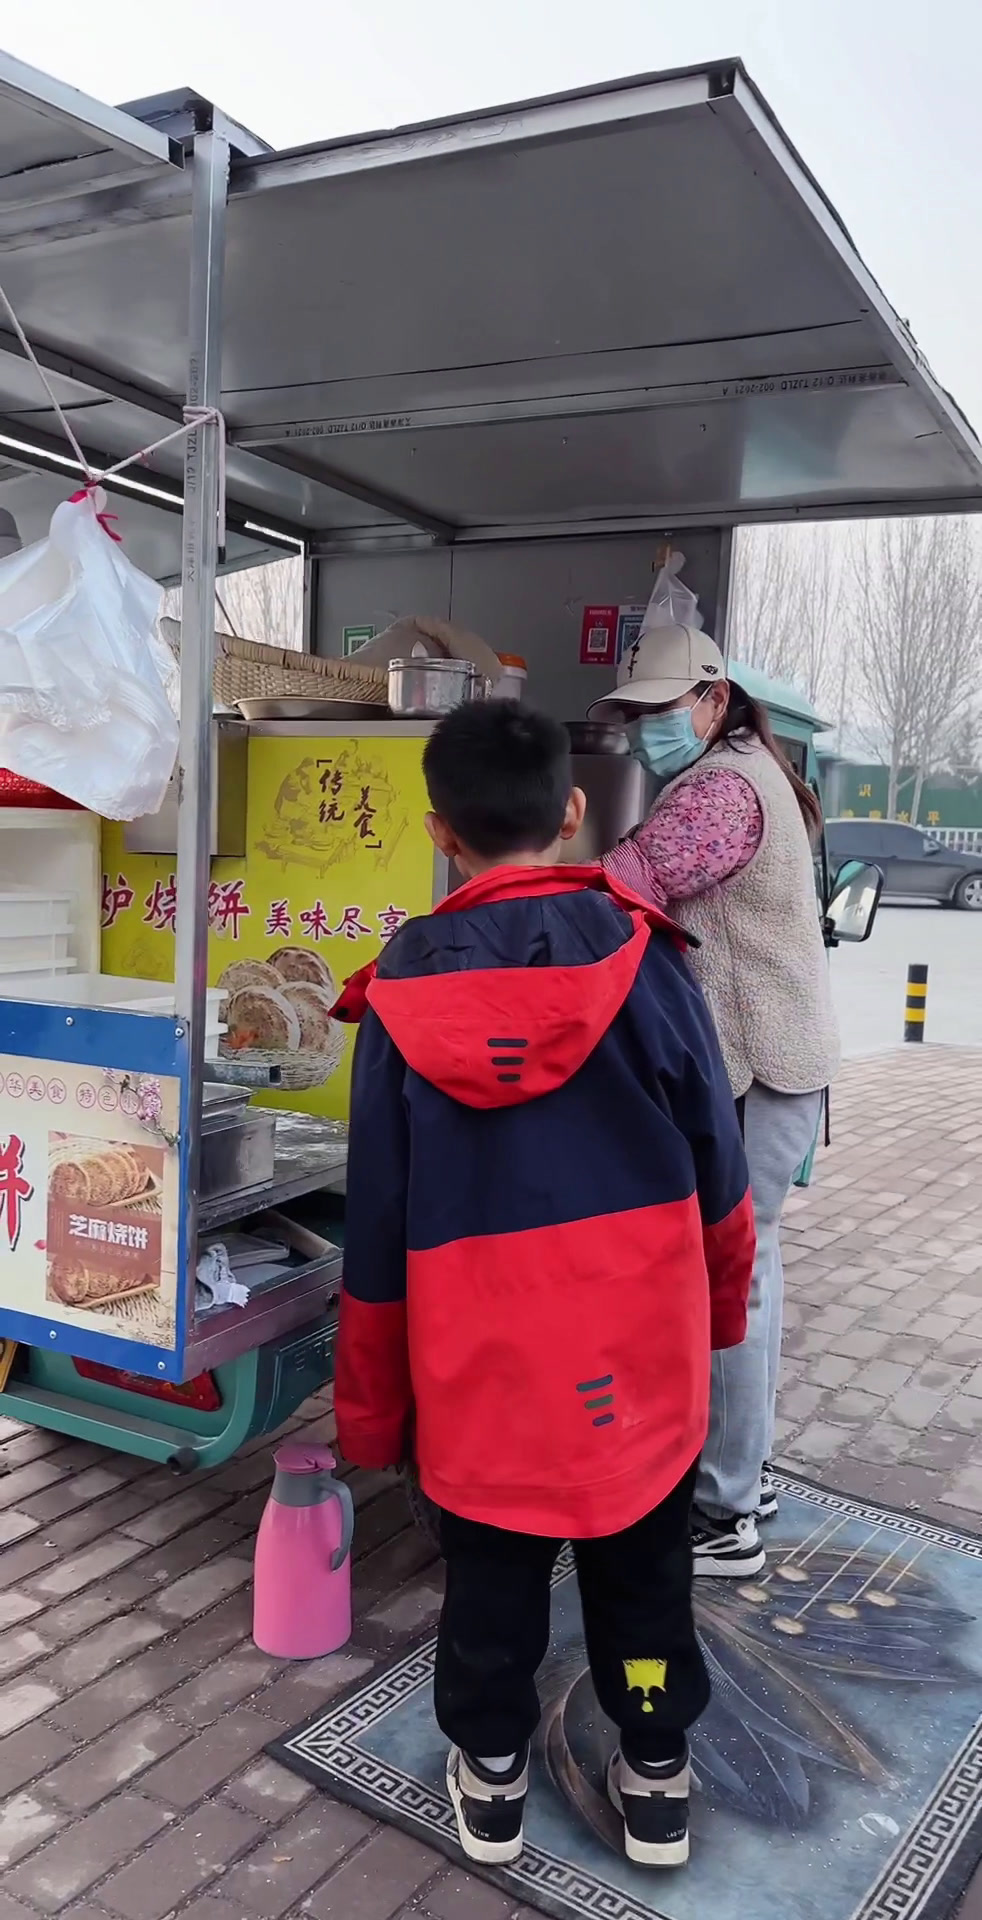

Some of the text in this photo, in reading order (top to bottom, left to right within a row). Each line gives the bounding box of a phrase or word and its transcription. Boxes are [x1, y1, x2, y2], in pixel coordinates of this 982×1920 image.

[319, 769, 344, 823] 传统
[353, 785, 376, 839] 美食
[264, 899, 408, 942] 美味尽享
[68, 1213, 149, 1250] 芝麻烧饼
